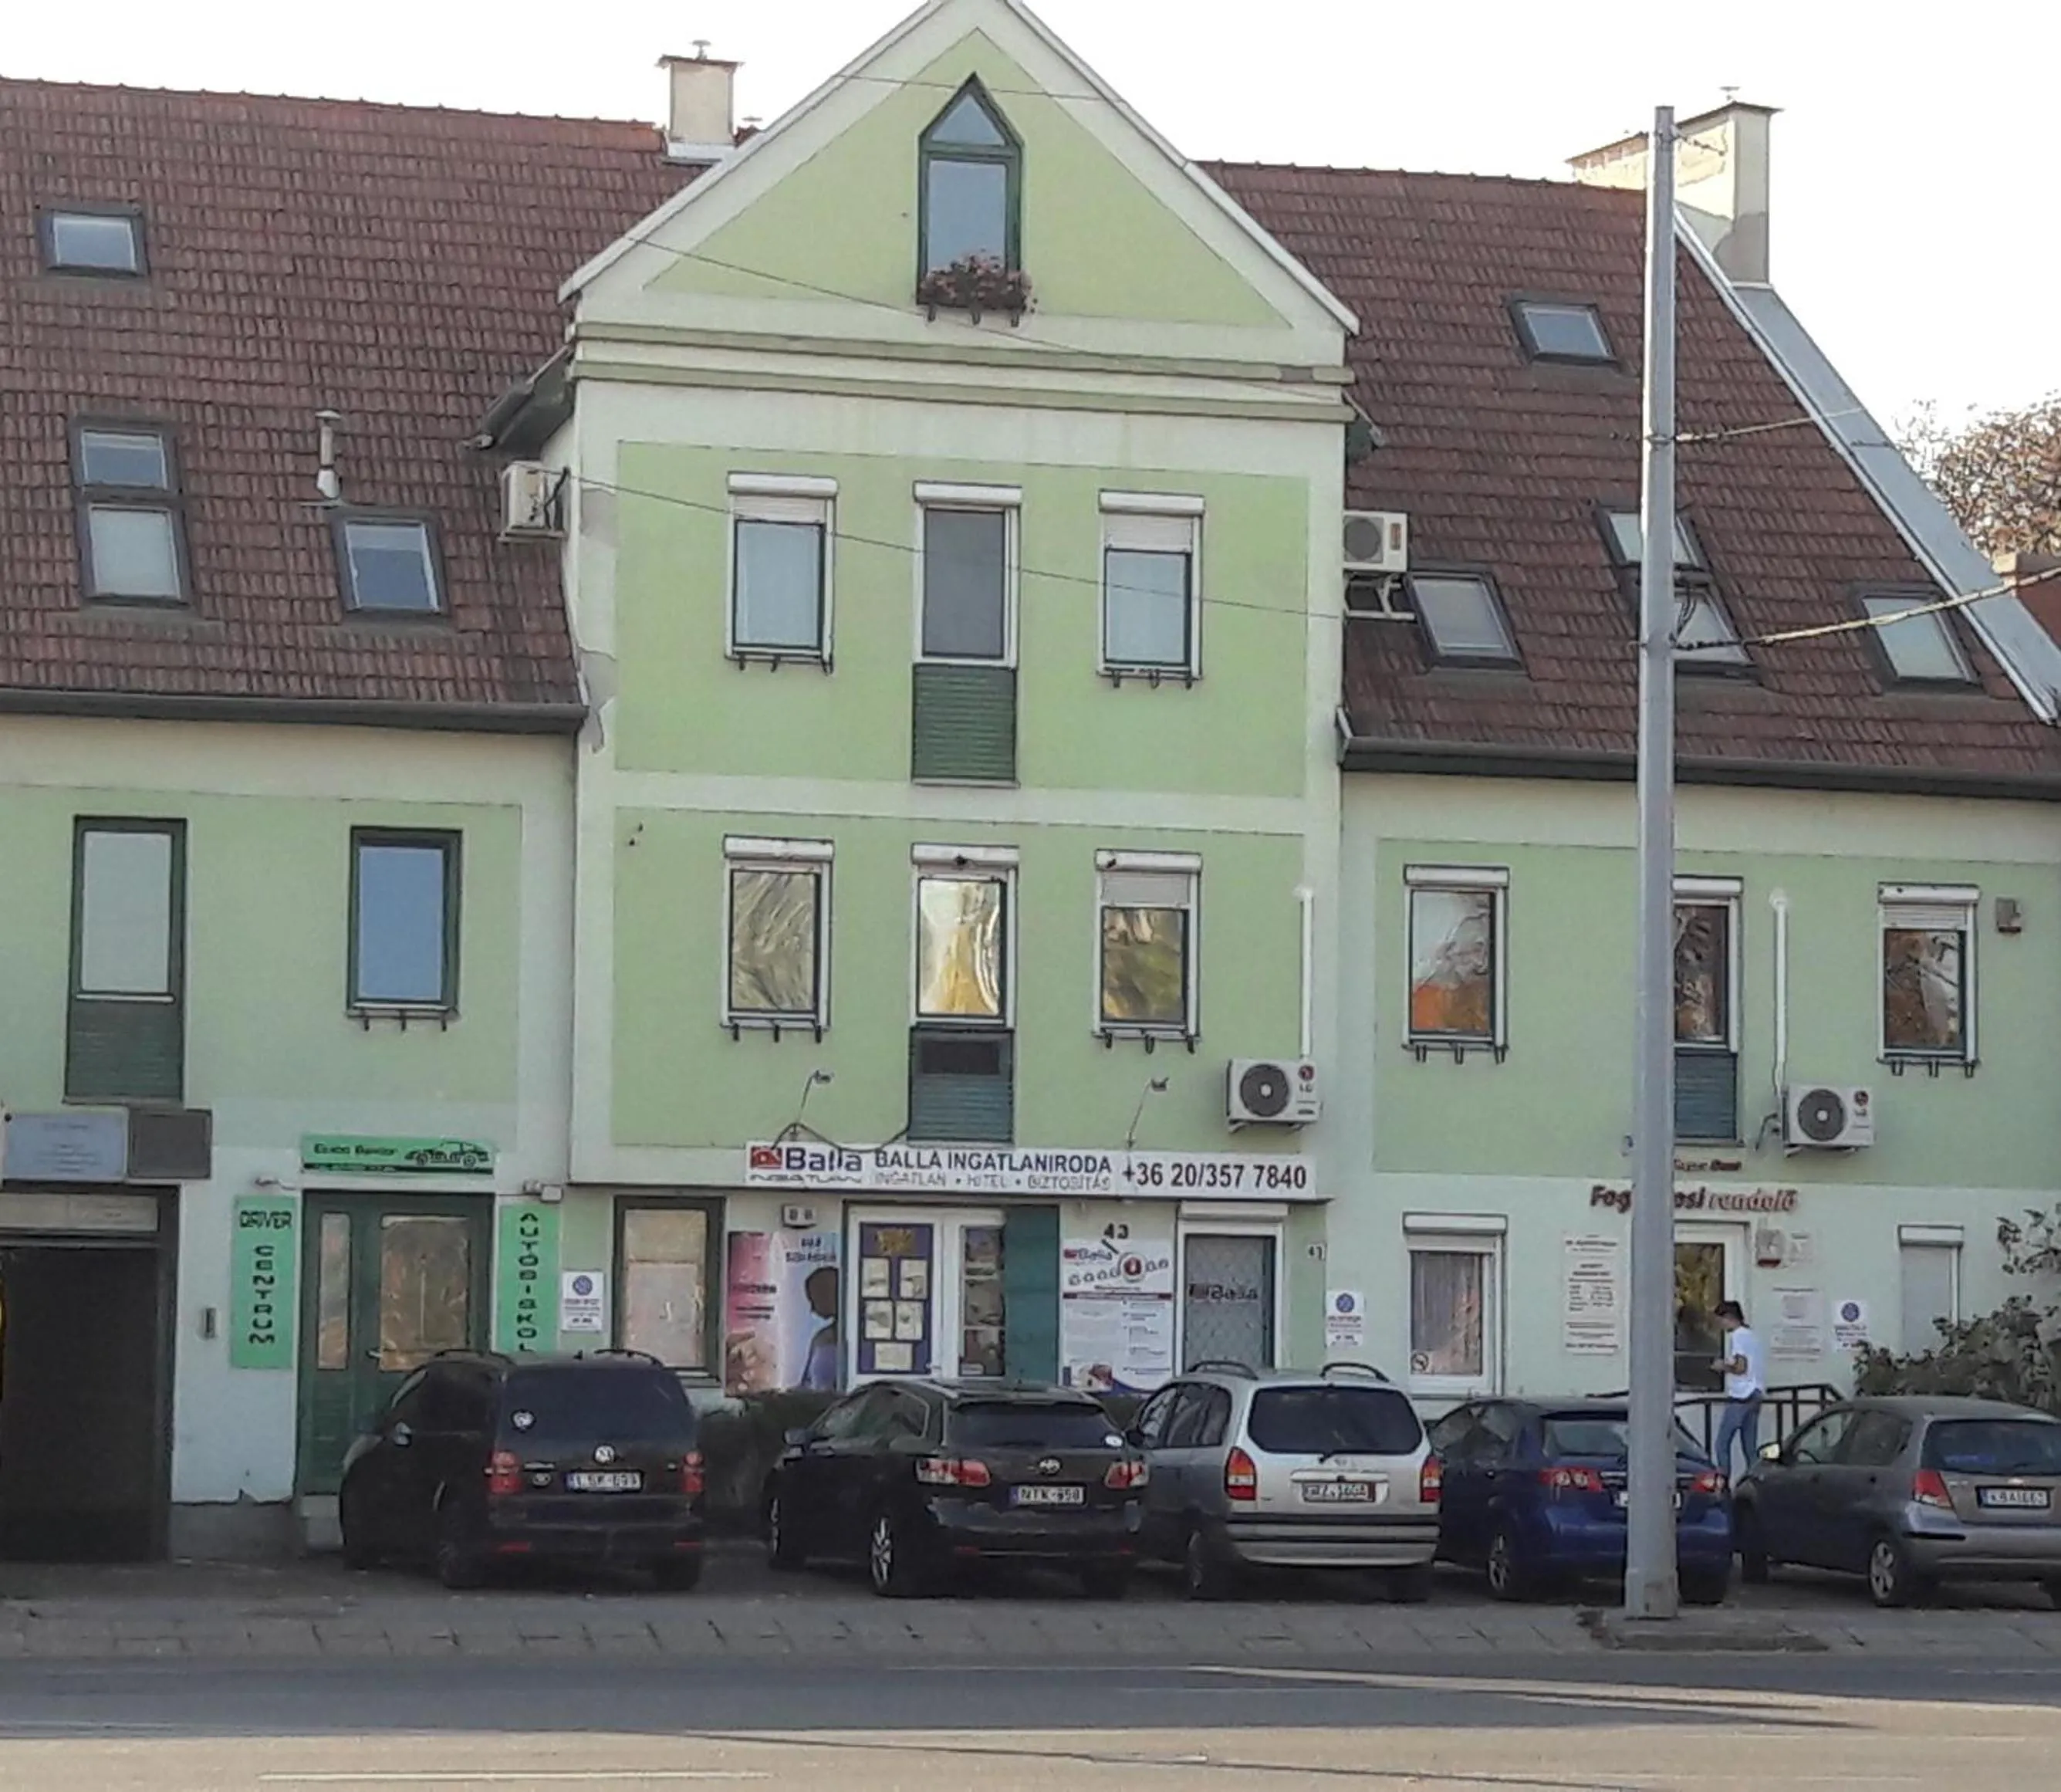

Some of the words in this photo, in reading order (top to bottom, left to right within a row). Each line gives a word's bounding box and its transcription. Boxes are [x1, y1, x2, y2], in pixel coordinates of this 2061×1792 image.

[786, 1147, 862, 1172] Balla
[874, 1149, 942, 1168] BALLA
[948, 1153, 1112, 1174] INGATLANIRODA
[873, 1171, 947, 1187] INGATLAN
[1123, 1160, 1163, 1186] +36
[1171, 1162, 1244, 1188] 20/357
[1253, 1164, 1307, 1189] 7840
[1590, 1185, 1706, 1214] Fogosi
[1103, 1222, 1130, 1239] 43
